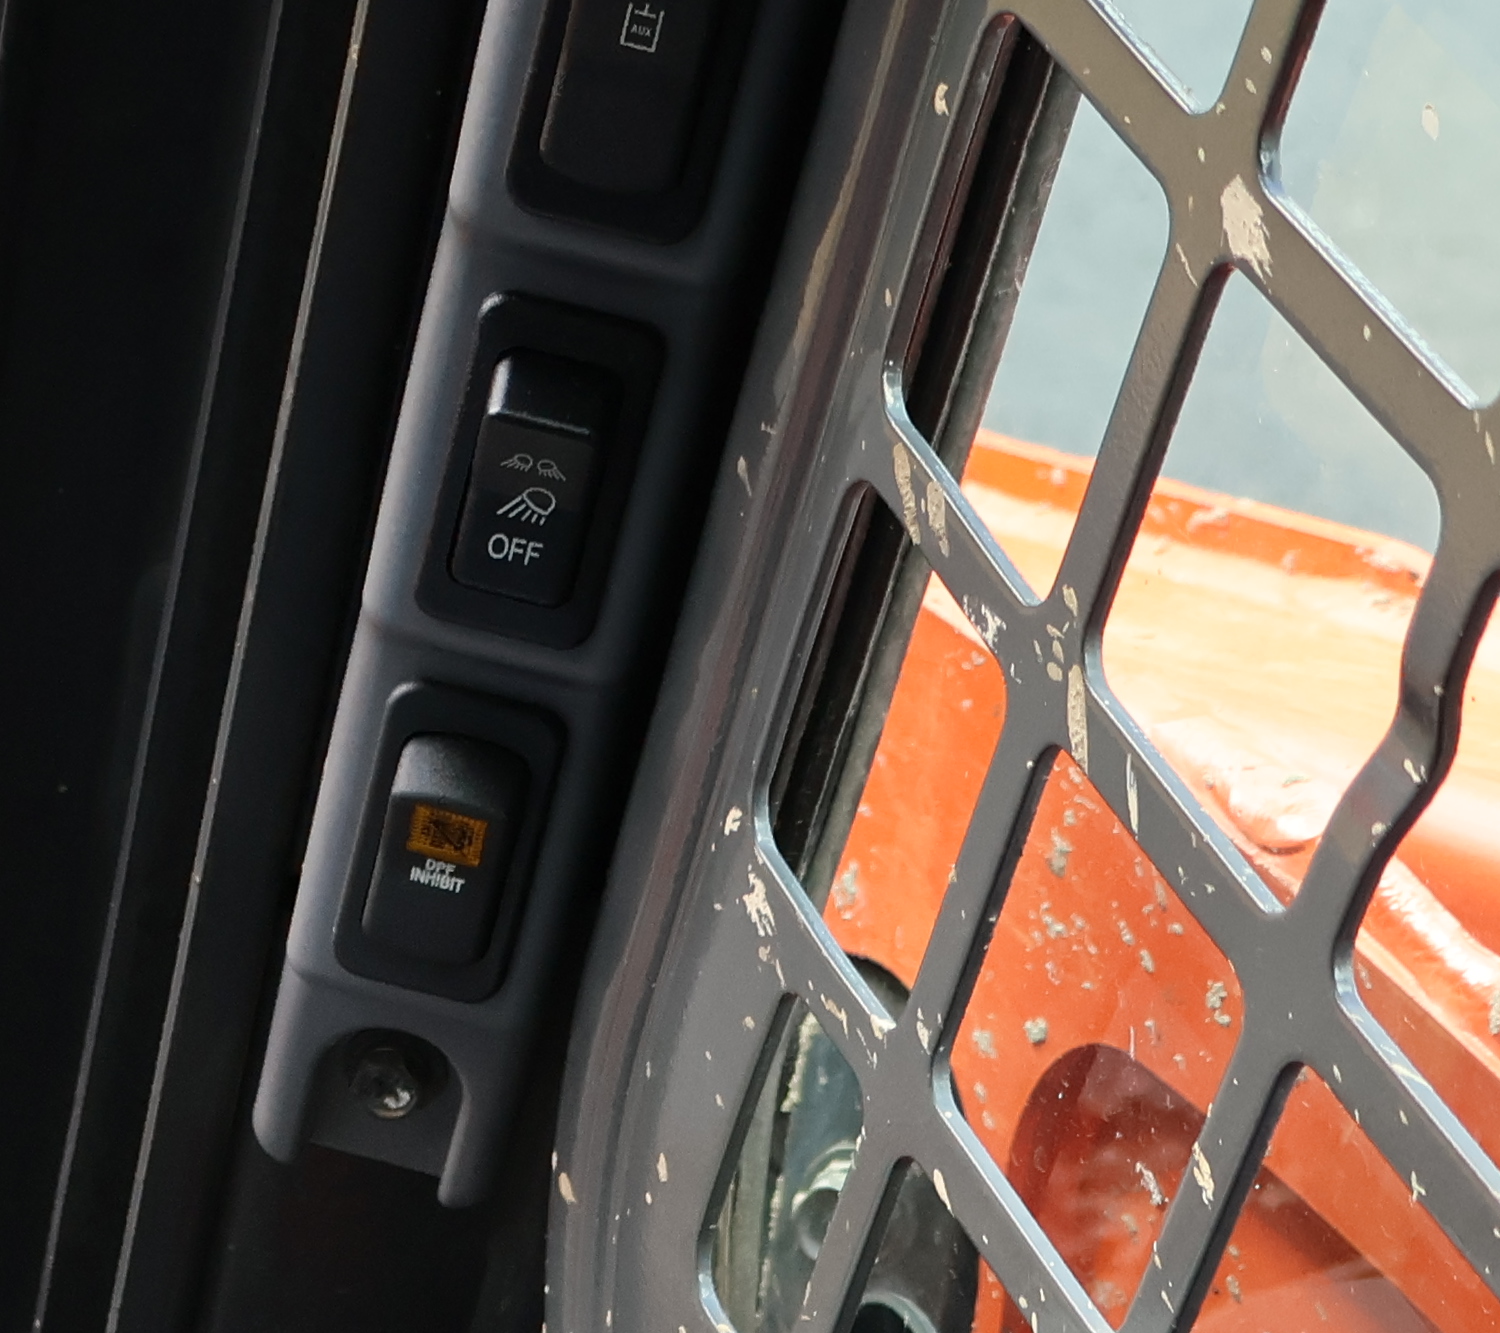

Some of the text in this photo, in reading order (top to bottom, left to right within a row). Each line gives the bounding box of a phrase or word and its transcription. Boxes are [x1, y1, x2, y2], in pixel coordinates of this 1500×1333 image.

[630, 23, 652, 37] AUX
[488, 533, 543, 566] OFF
[425, 858, 457, 875] DPF
[409, 866, 466, 893] INHIBIT
